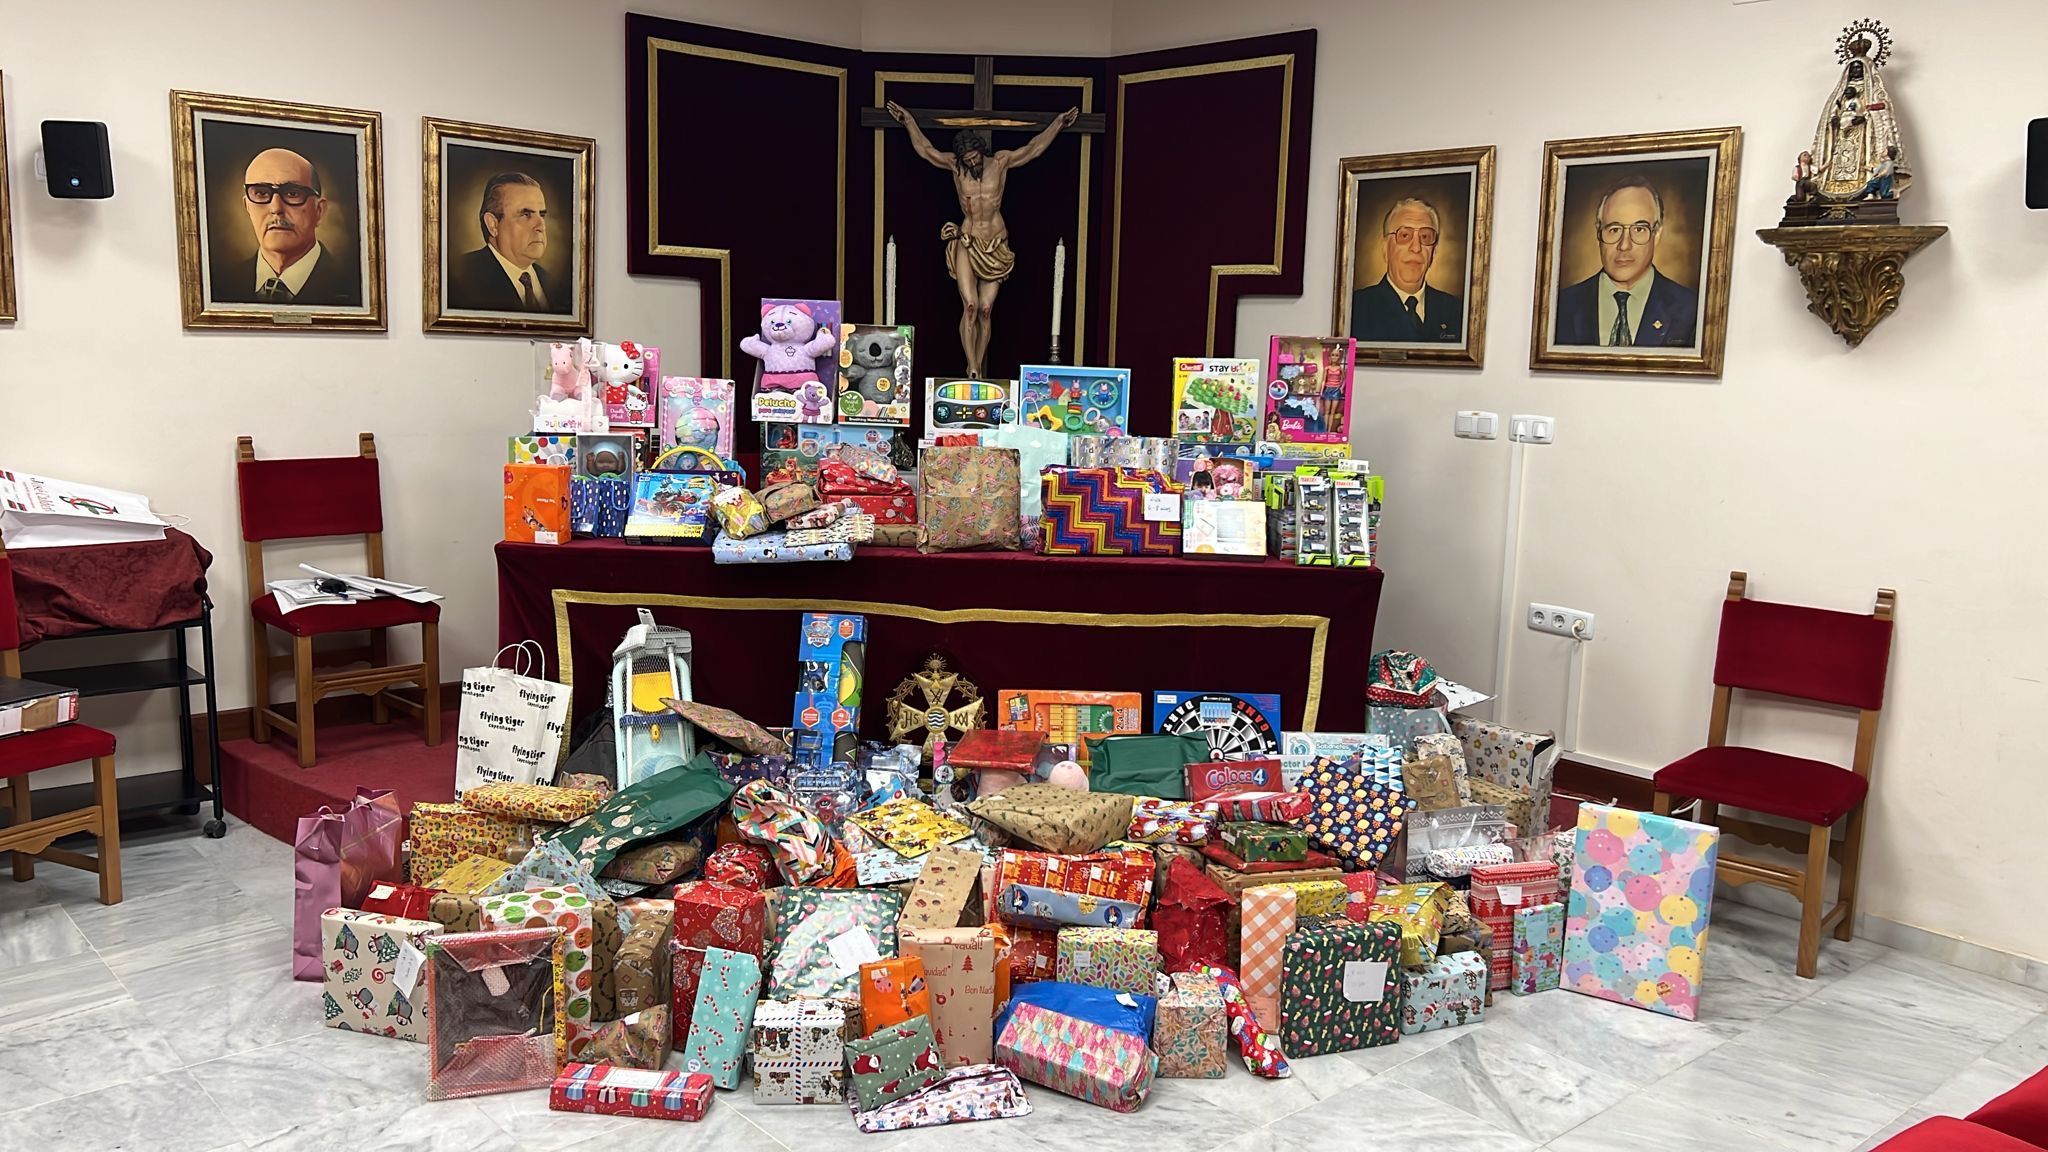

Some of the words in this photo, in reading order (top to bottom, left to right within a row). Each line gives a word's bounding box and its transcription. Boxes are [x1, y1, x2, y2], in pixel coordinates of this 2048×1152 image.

[1281, 419, 1303, 431] Barbie
[473, 681, 495, 693] tiger
[519, 689, 540, 702] flying
[479, 711, 504, 725] flying
[505, 716, 525, 728] tiger
[1237, 700, 1270, 731] GAME
[546, 721, 565, 733] flyi
[469, 735, 490, 748] tiger
[512, 745, 530, 758] flying
[476, 765, 497, 780] flying
[497, 770, 515, 783] tiger
[1206, 767, 1253, 789] Coloca
[1253, 768, 1267, 786] 4
